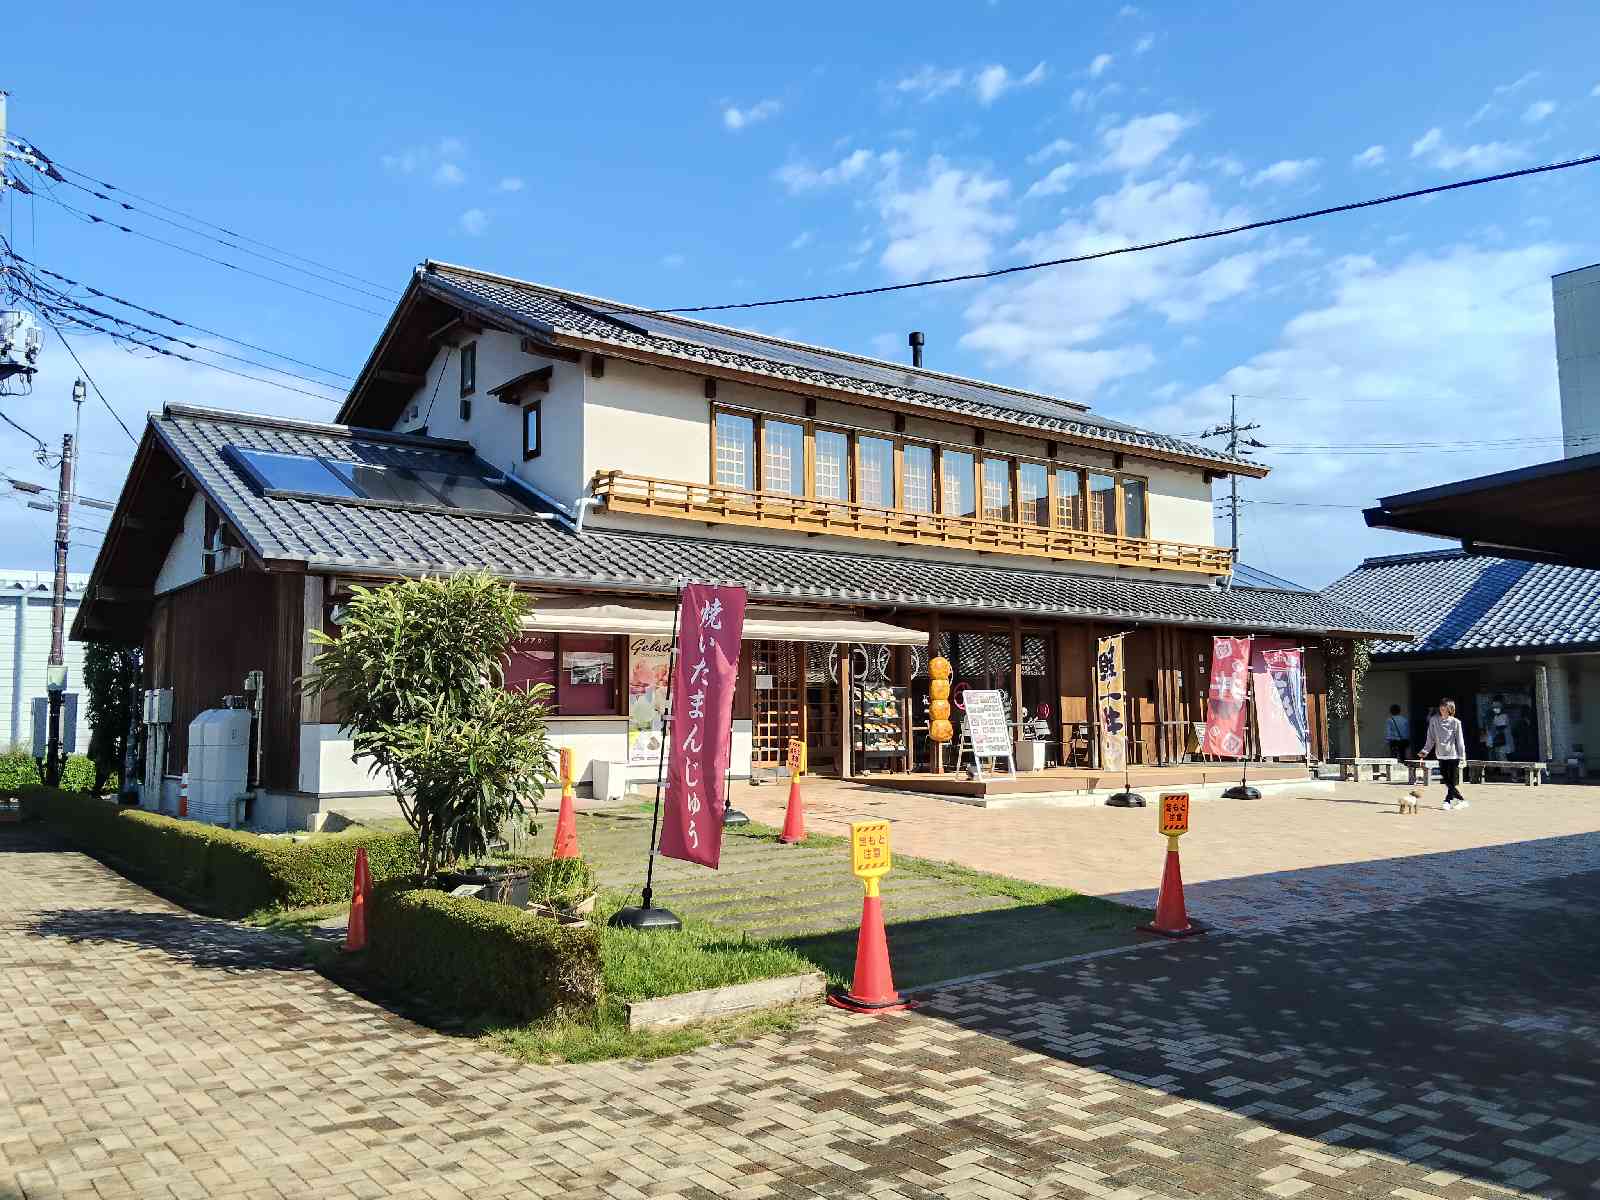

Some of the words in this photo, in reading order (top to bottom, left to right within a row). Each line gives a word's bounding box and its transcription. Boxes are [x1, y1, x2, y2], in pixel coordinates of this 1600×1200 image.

[682, 598, 724, 850] 焼いたまんじゅう
